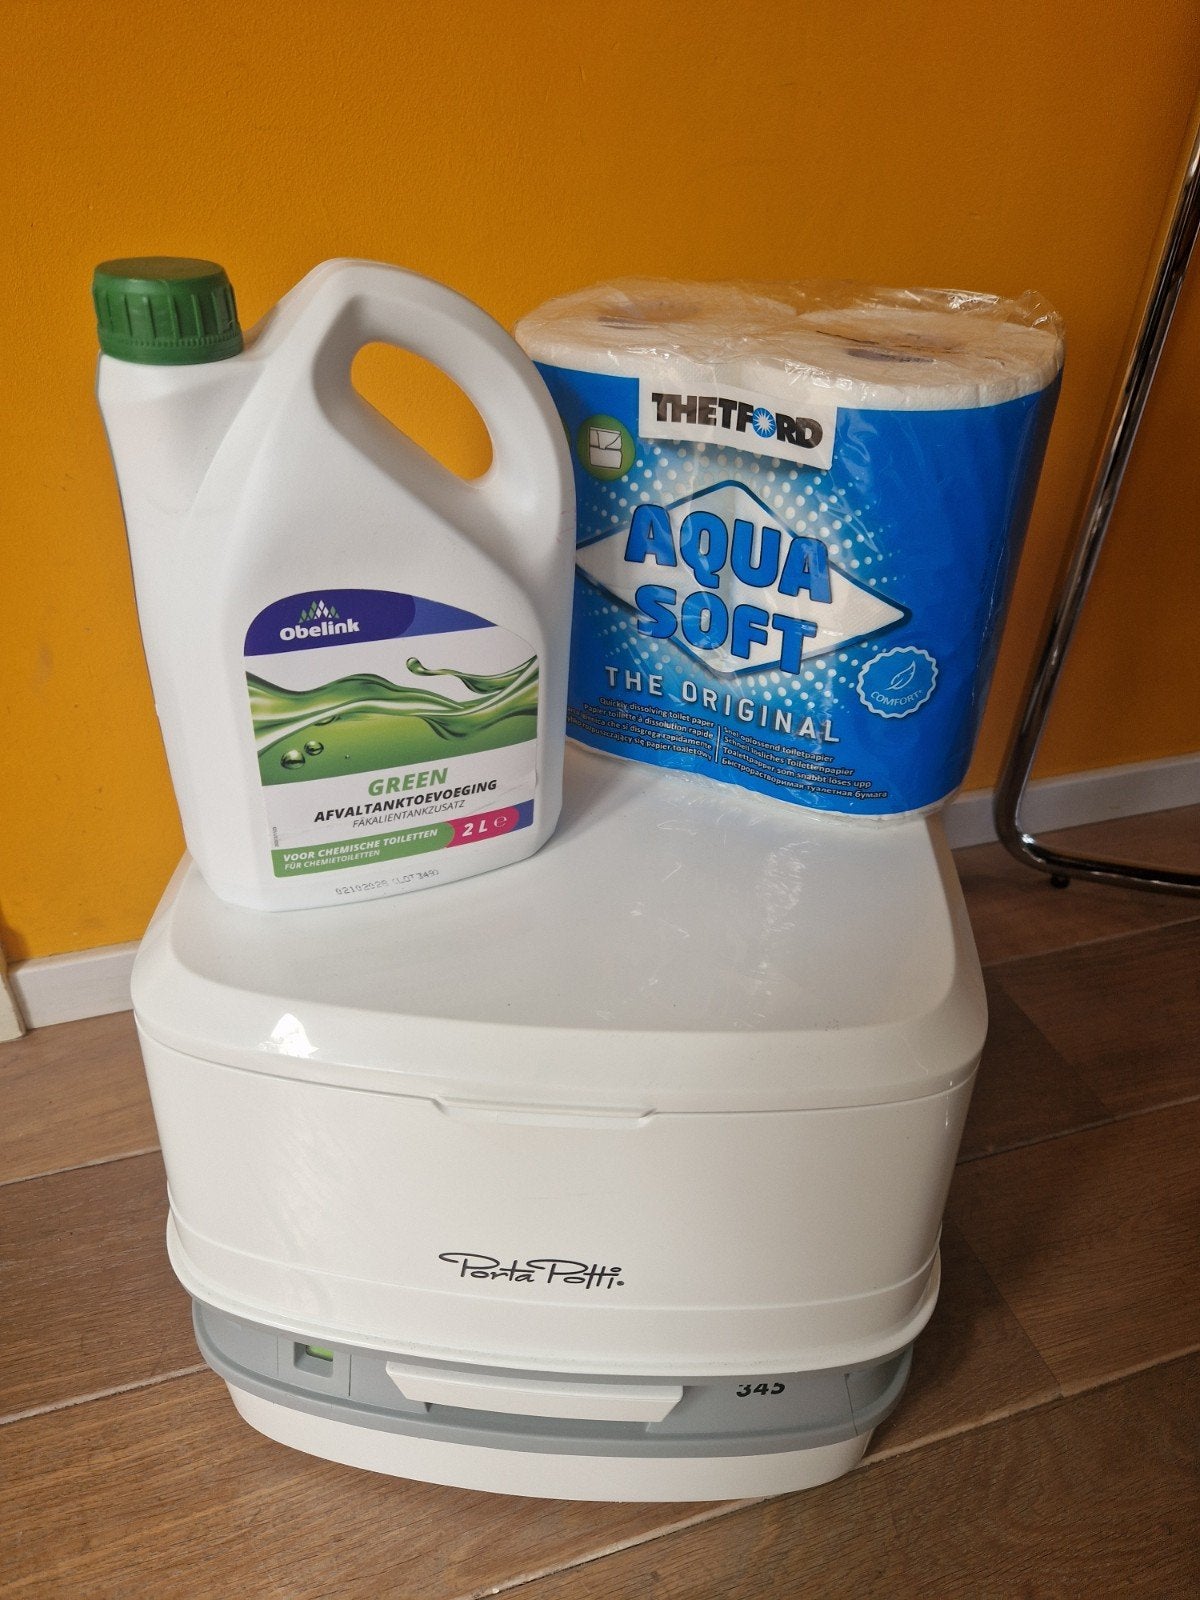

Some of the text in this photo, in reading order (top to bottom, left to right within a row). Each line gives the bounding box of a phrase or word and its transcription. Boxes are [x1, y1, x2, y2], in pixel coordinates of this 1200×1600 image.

[652, 392, 823, 449] THETFORD
[624, 504, 833, 604] AQUA
[280, 618, 360, 641] Obelink
[635, 584, 818, 675] SOFT
[599, 697, 715, 728] Quickly dissolving toilet paper
[605, 666, 840, 742] THE ORIGINAL
[583, 703, 607, 716] Papier
[608, 711, 637, 722] toilette
[644, 717, 687, 732] dissolution
[688, 727, 714, 739] rapide
[607, 720, 621, 729] che
[630, 724, 661, 738] disgrega
[662, 733, 712, 750] rapidamente
[646, 740, 671, 751] papier
[673, 744, 712, 761] toaletowy
[723, 726, 834, 762] Snel oplossend toiletpapier
[724, 736, 750, 752] Schnell
[787, 758, 854, 776] Toilettenpapier
[368, 768, 448, 796] GREEN
[723, 746, 871, 789] Toalettpapper som snabbt löses upp
[314, 779, 498, 822] AFVALTANKTOEVOEGING
[806, 785, 853, 797] туалетная
[854, 790, 888, 800] бумага
[352, 799, 466, 828] FÄKALIENTANKZUSATZ
[462, 823, 474, 837] 2
[478, 820, 488, 833] L
[283, 829, 439, 863] VOOR CHEMISCHE TOILETTEN
[284, 850, 381, 871] FÜR CHEMIETOILETTEN
[438, 1252, 536, 1283] Porta
